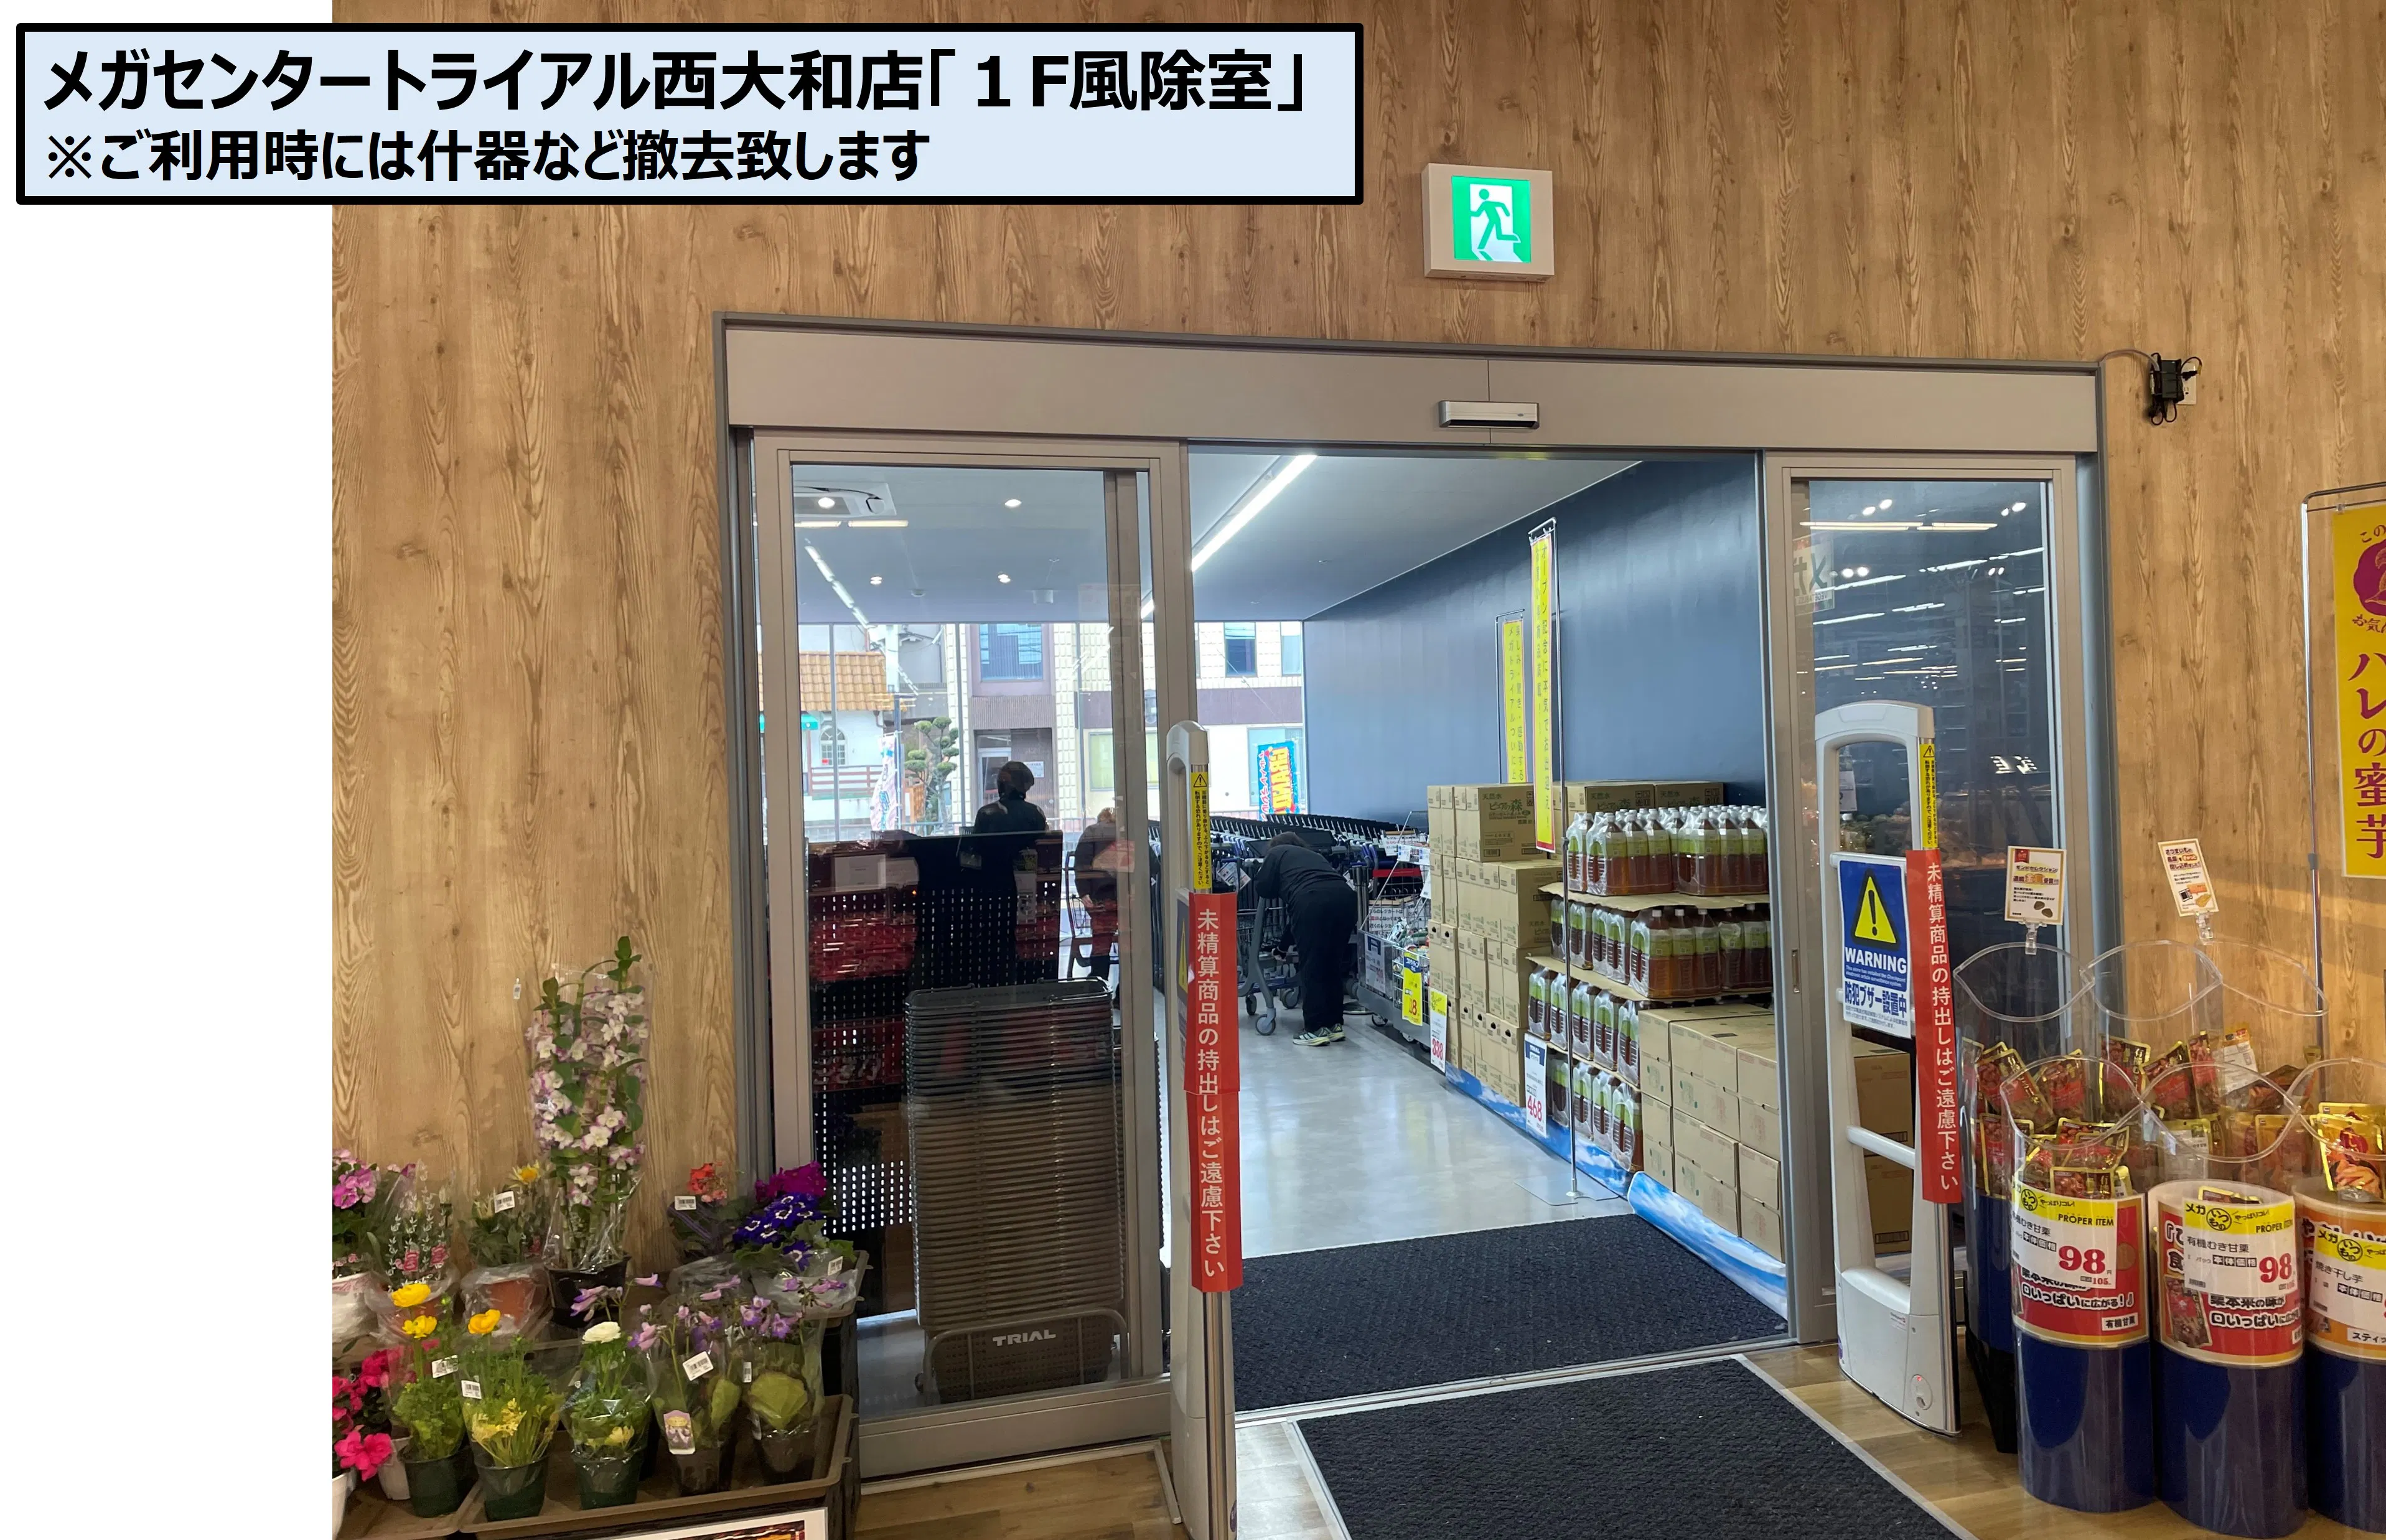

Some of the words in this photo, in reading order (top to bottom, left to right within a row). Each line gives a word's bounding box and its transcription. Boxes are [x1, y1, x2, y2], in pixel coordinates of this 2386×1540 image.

[1845, 946, 1907, 974] WARNING
[1845, 981, 1907, 1018] 防犯ブザー設置中
[1927, 862, 1958, 1190] 未精算商品の持出しはご遠慮下さい
[1197, 908, 1225, 1277] 未精算商品の持出しはご遠慮下さい
[1528, 1096, 1542, 1122] 468
[2058, 1214, 2092, 1226] PROPER
[2096, 1218, 2114, 1226] ITEM
[2186, 1203, 2206, 1215] メガ
[2256, 1222, 2283, 1233] PROPER
[2187, 1236, 2249, 1253] 有機むき甘栗
[2059, 1246, 2105, 1274] 98
[2259, 1253, 2292, 1283] 98
[993, 1330, 1057, 1346] TRIAL
